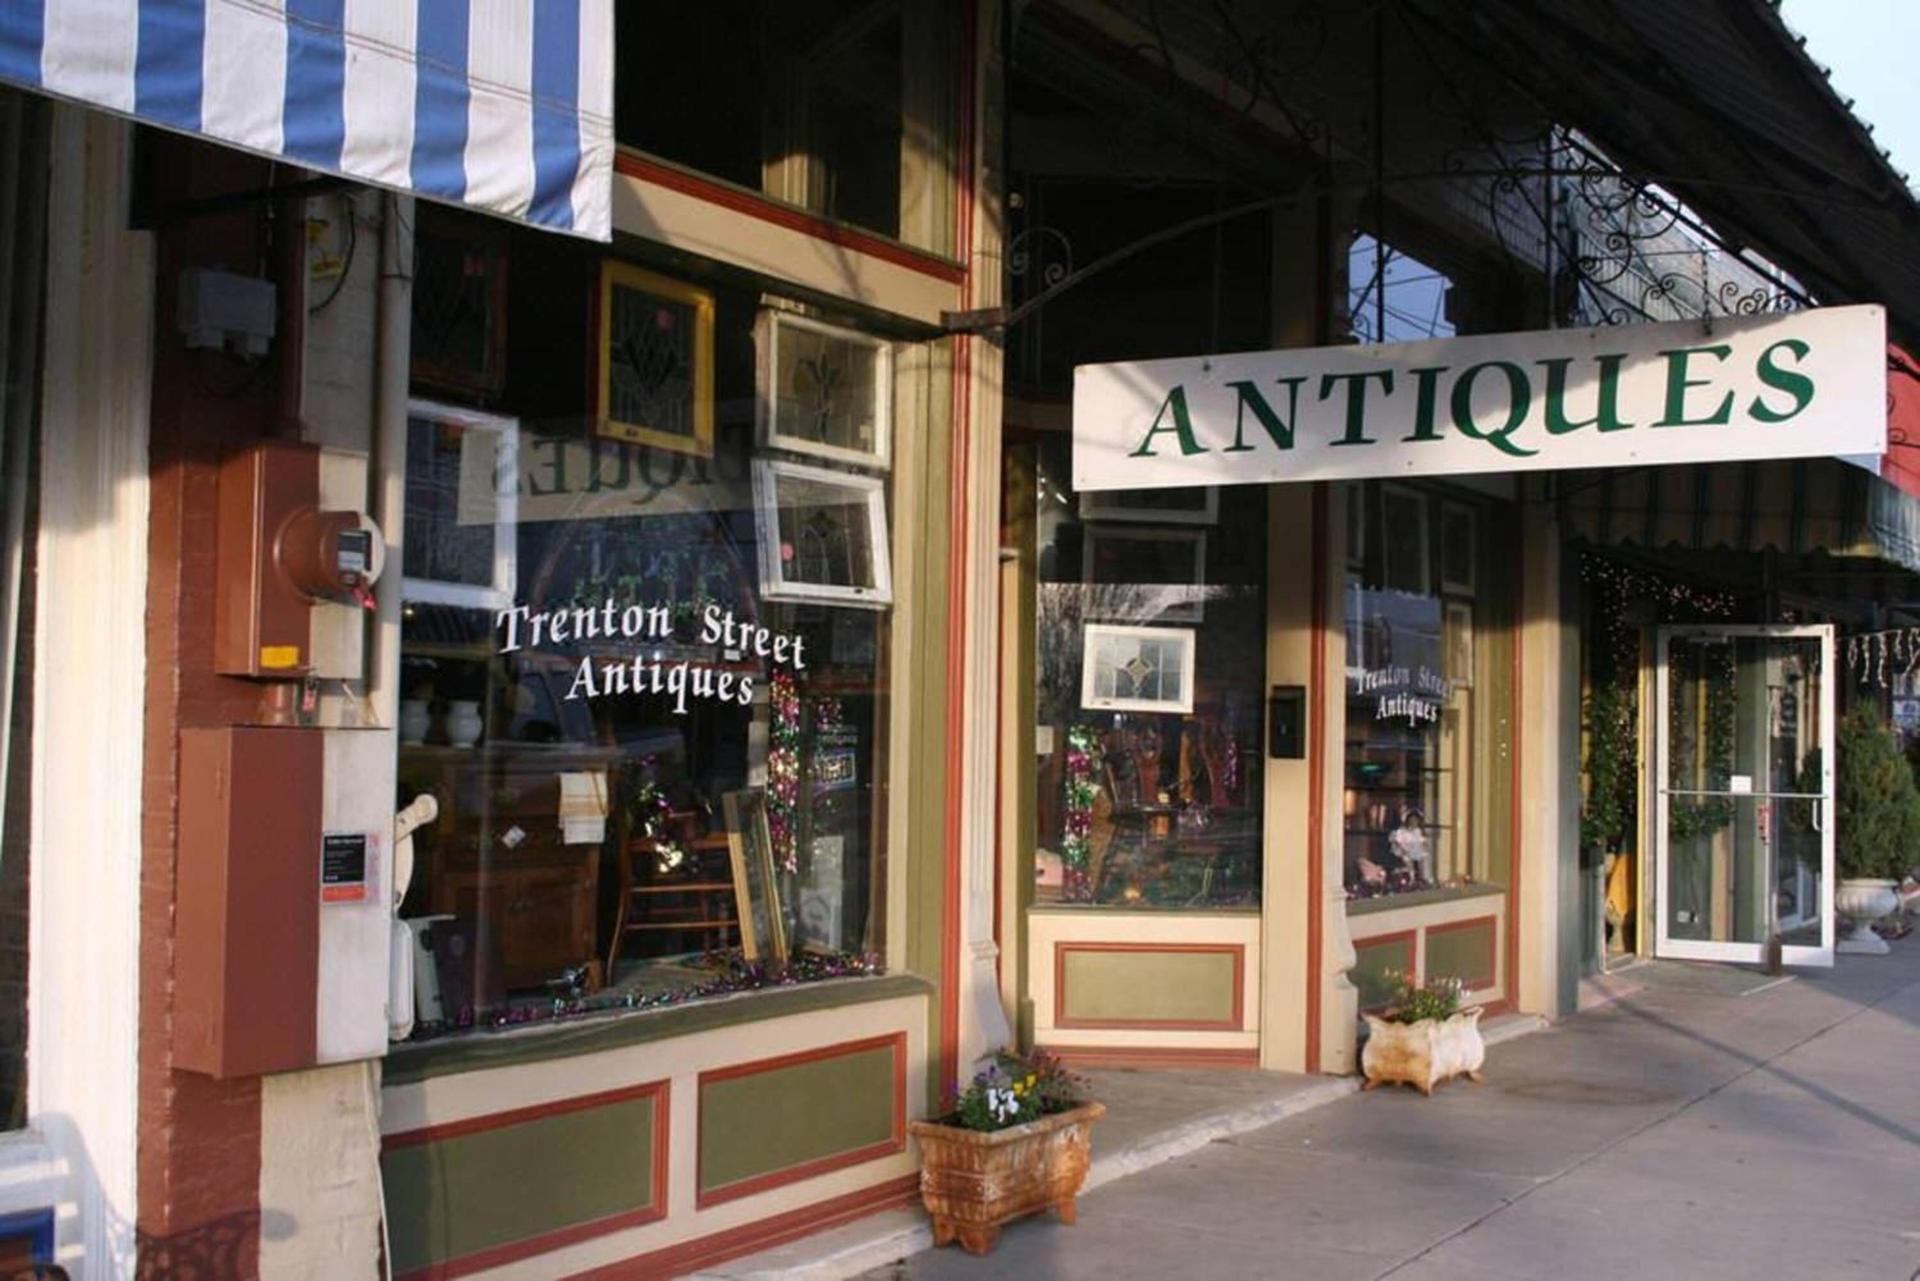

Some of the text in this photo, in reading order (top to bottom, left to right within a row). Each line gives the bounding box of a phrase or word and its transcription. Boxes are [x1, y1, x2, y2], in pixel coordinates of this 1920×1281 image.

[1128, 338, 1817, 458] ANTIQUES
[496, 597, 806, 670] Trenton Street
[564, 650, 754, 715] Antiques
[1375, 691, 1438, 728] Antiques
